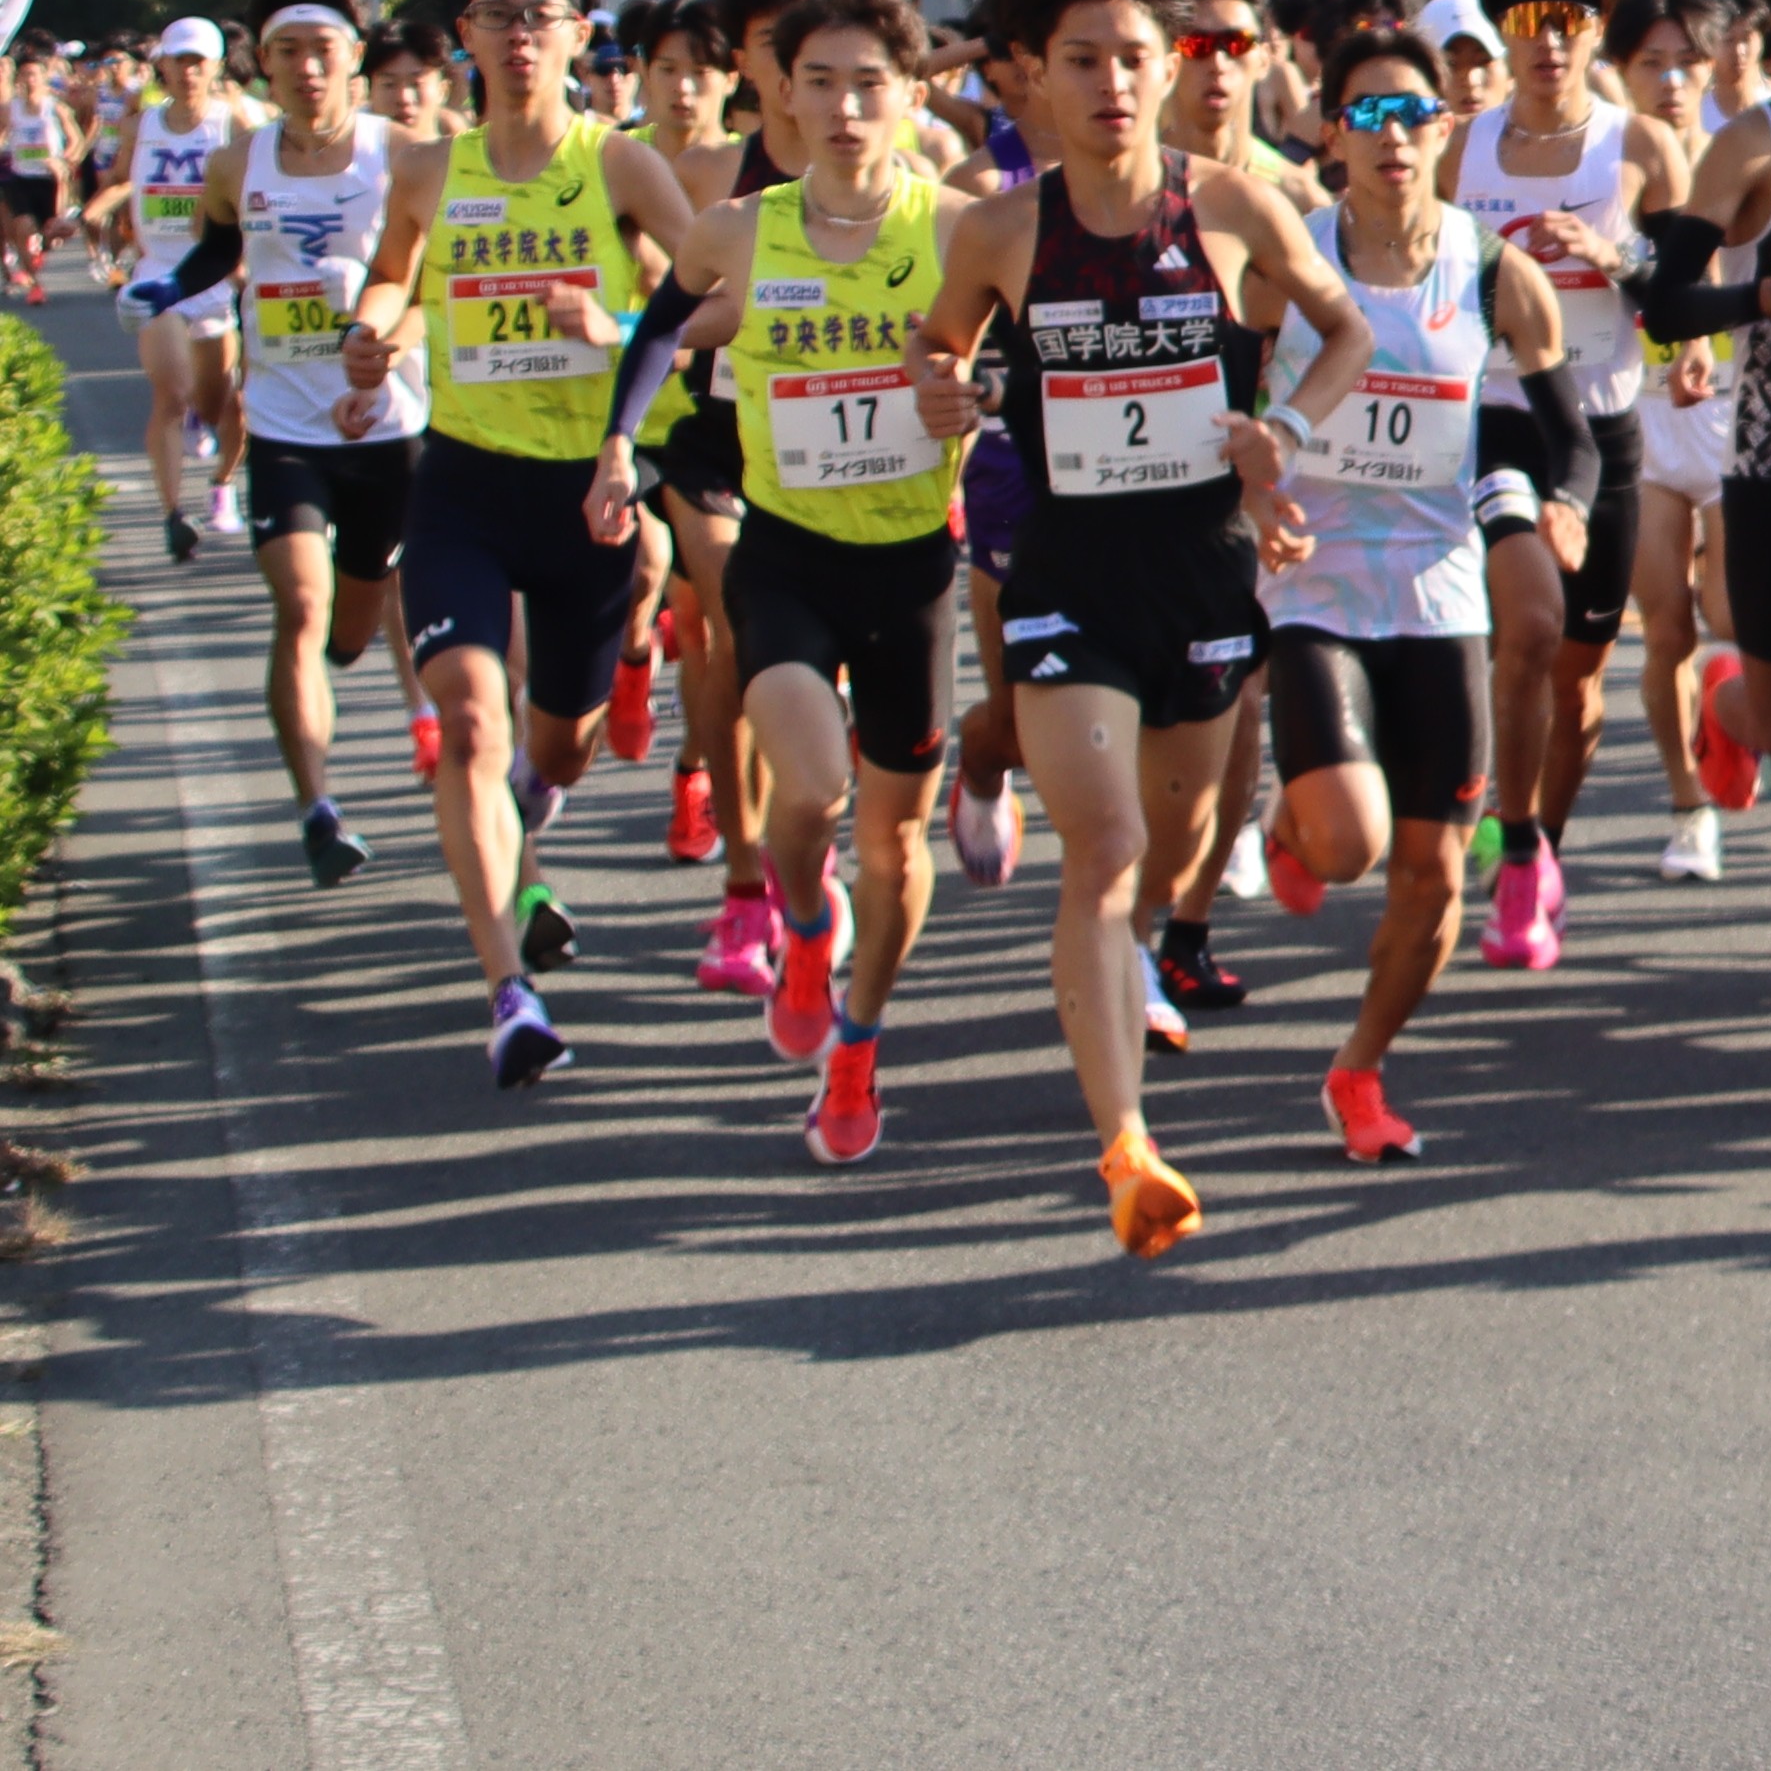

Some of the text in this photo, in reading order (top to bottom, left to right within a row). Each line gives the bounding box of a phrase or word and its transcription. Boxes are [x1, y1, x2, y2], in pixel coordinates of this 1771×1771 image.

[147, 148, 205, 183] M
[452, 226, 591, 268] 中央学院大学
[1031, 318, 1215, 364] 国学院大学
[487, 354, 569, 376] アイダ設計
[830, 395, 879, 444] 17
[1122, 399, 1149, 447] 2
[1365, 399, 1412, 446] 10
[818, 456, 907, 480] アイダ設計
[1094, 462, 1192, 486] アイダ設計
[1338, 458, 1424, 481] アイダ設計
